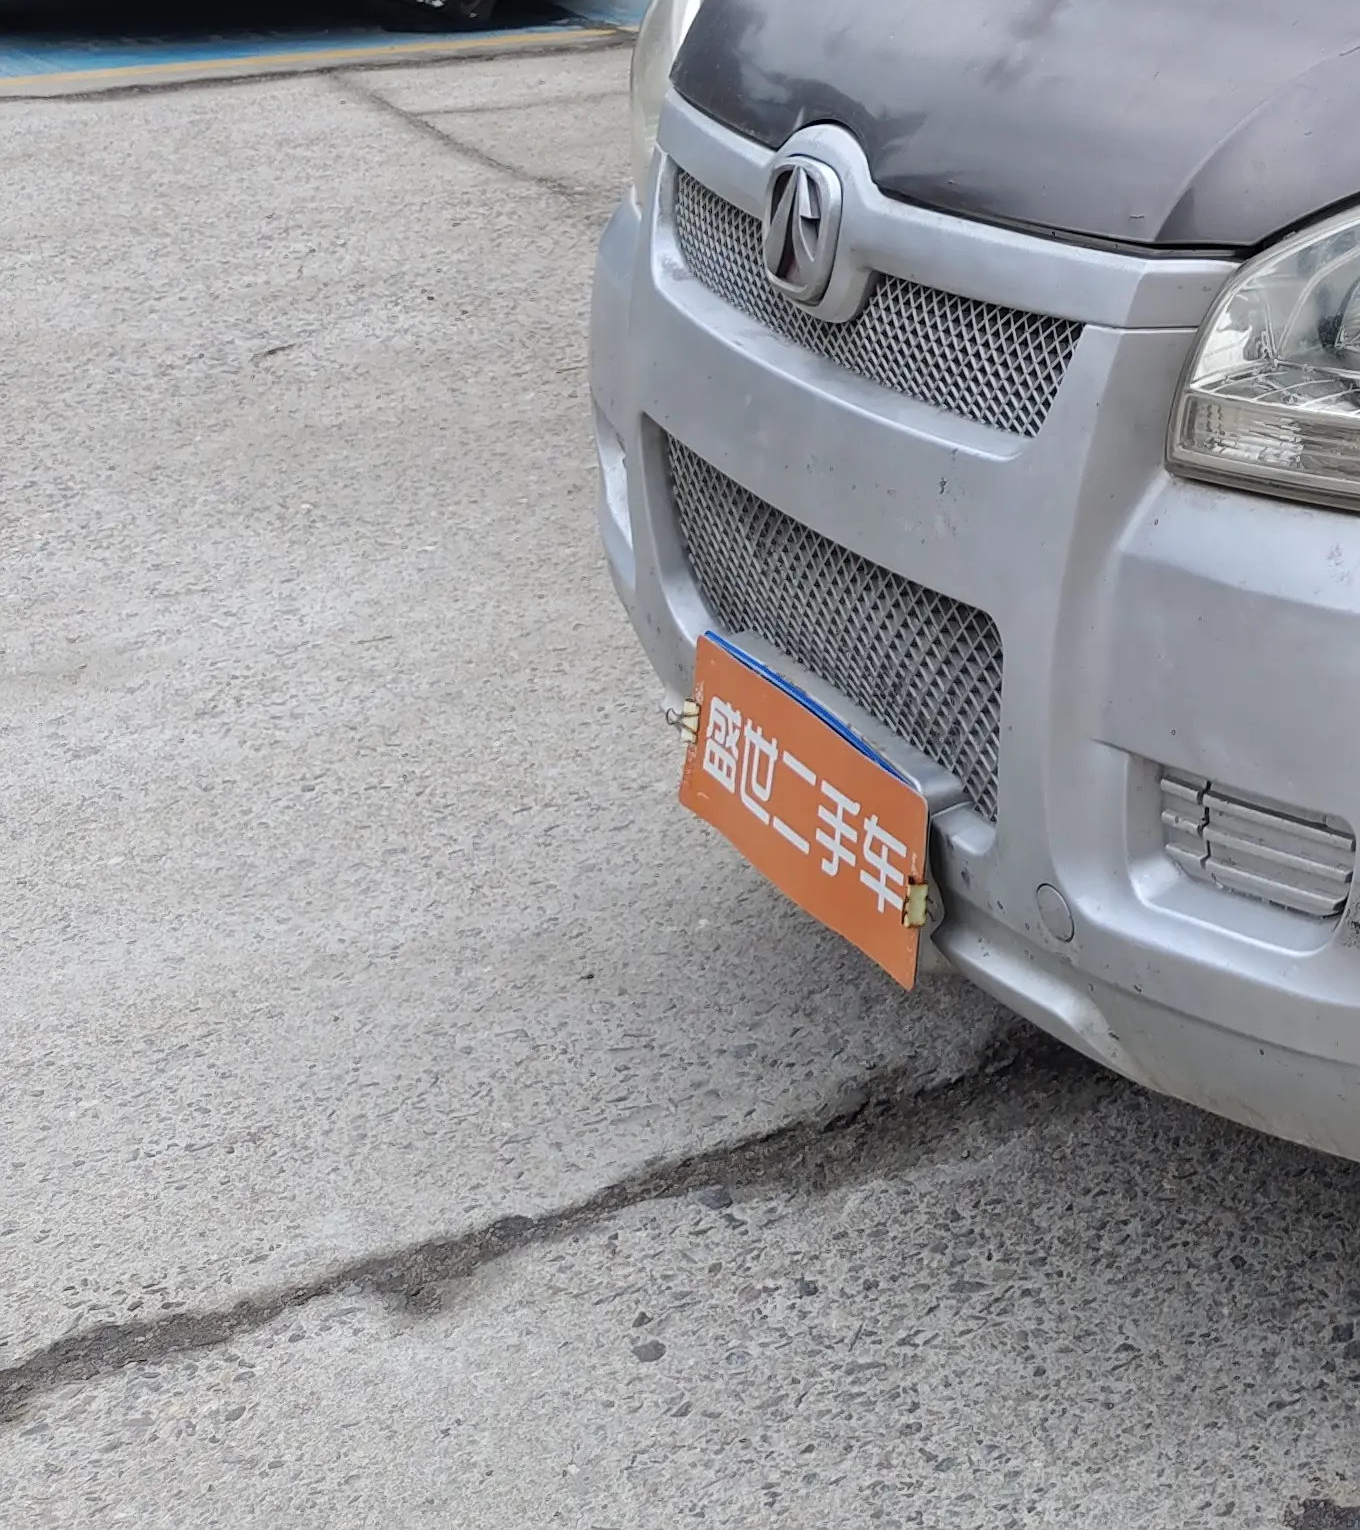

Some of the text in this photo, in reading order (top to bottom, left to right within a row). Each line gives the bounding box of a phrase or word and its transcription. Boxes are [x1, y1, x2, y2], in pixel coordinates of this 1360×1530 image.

[702, 695, 908, 914] 盛世二手车
